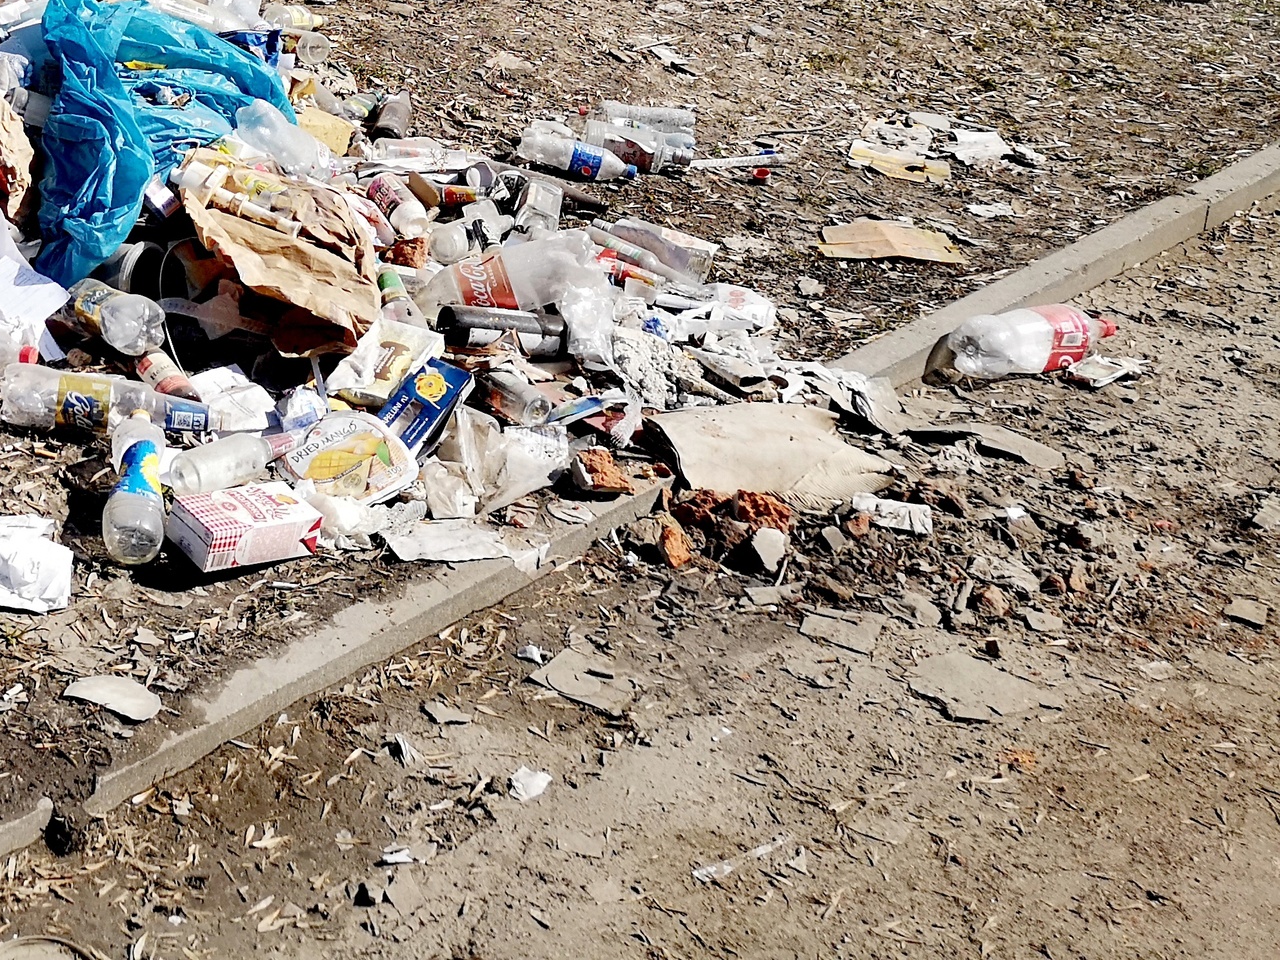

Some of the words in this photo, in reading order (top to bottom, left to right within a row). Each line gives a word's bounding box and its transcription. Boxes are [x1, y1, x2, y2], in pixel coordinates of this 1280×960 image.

[66, 391, 94, 431] Gold
[383, 401, 403, 425] APELLINI
[290, 442, 320, 464] DRIED
[320, 419, 358, 445] MANGO
